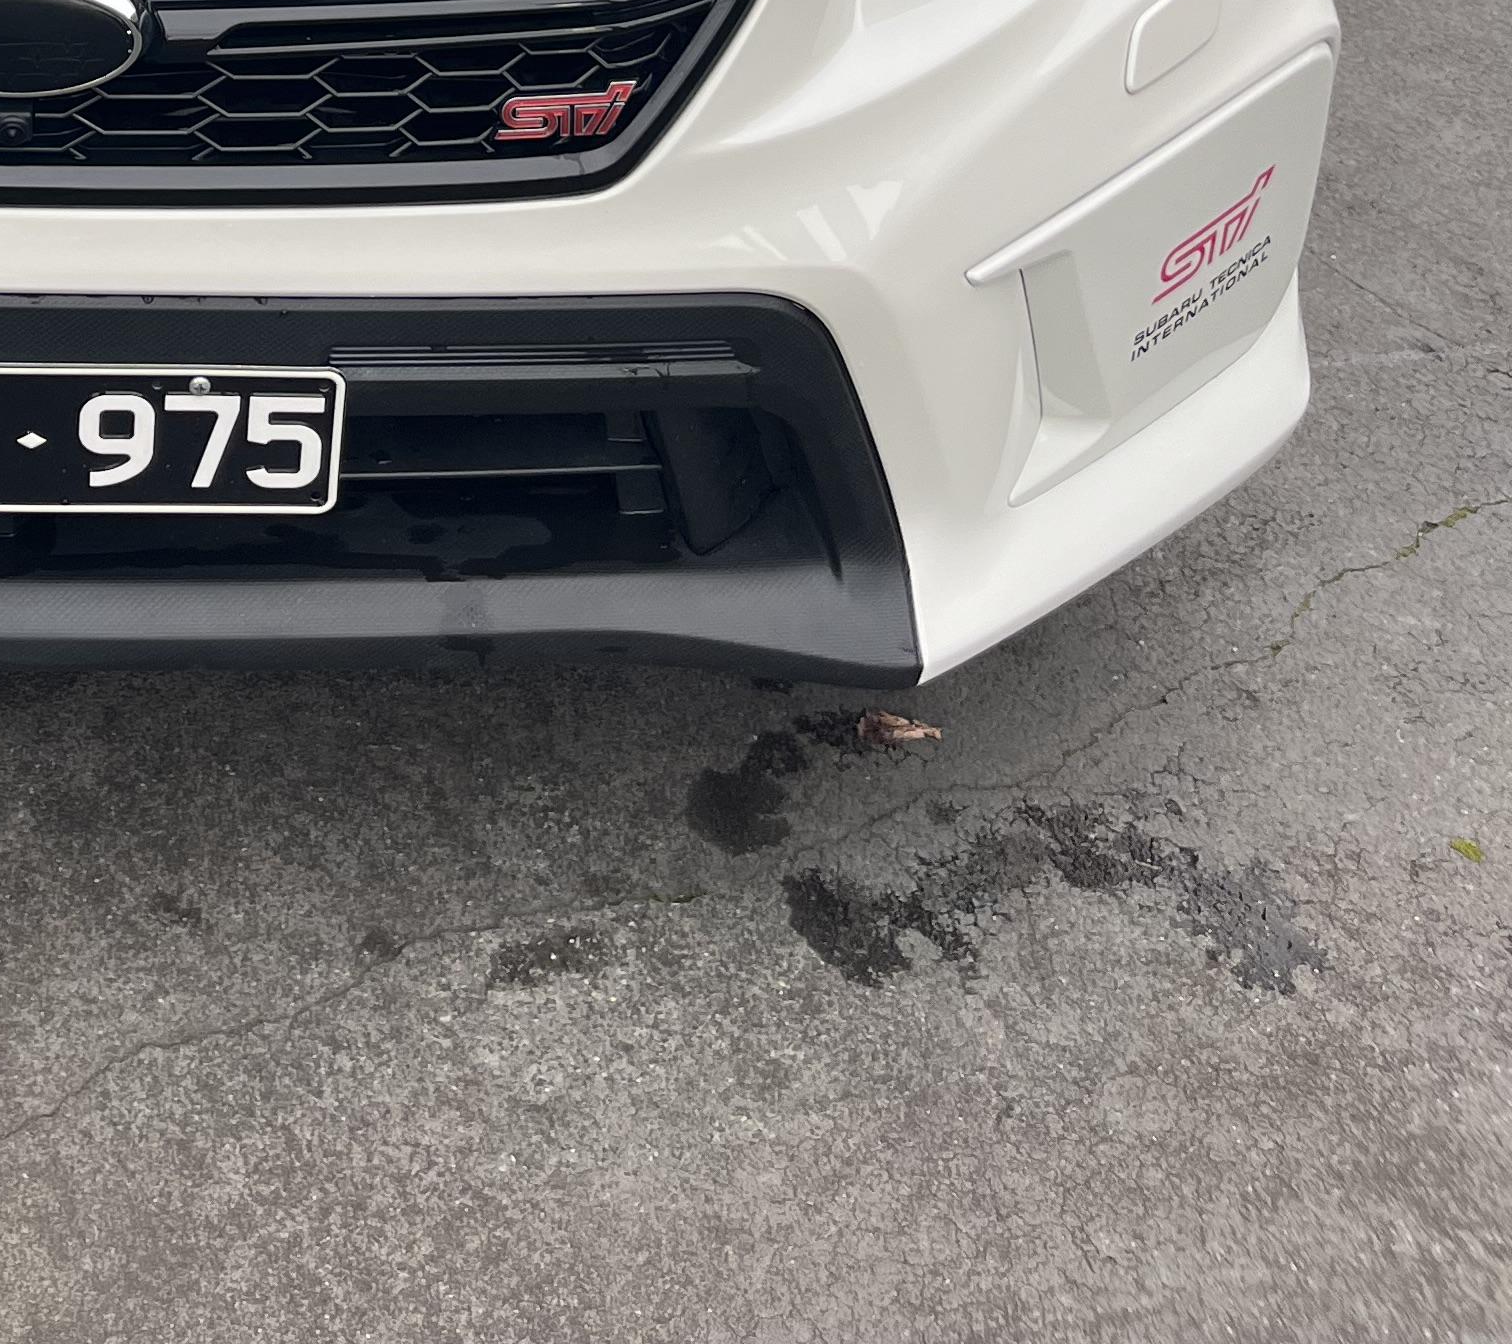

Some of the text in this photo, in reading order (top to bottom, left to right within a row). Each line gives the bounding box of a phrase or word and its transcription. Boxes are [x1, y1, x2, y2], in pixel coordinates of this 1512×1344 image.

[1131, 251, 1269, 362] INTERNATIONAL
[1134, 235, 1271, 346] SUBARU TECNICA
[77, 392, 326, 489] 975
